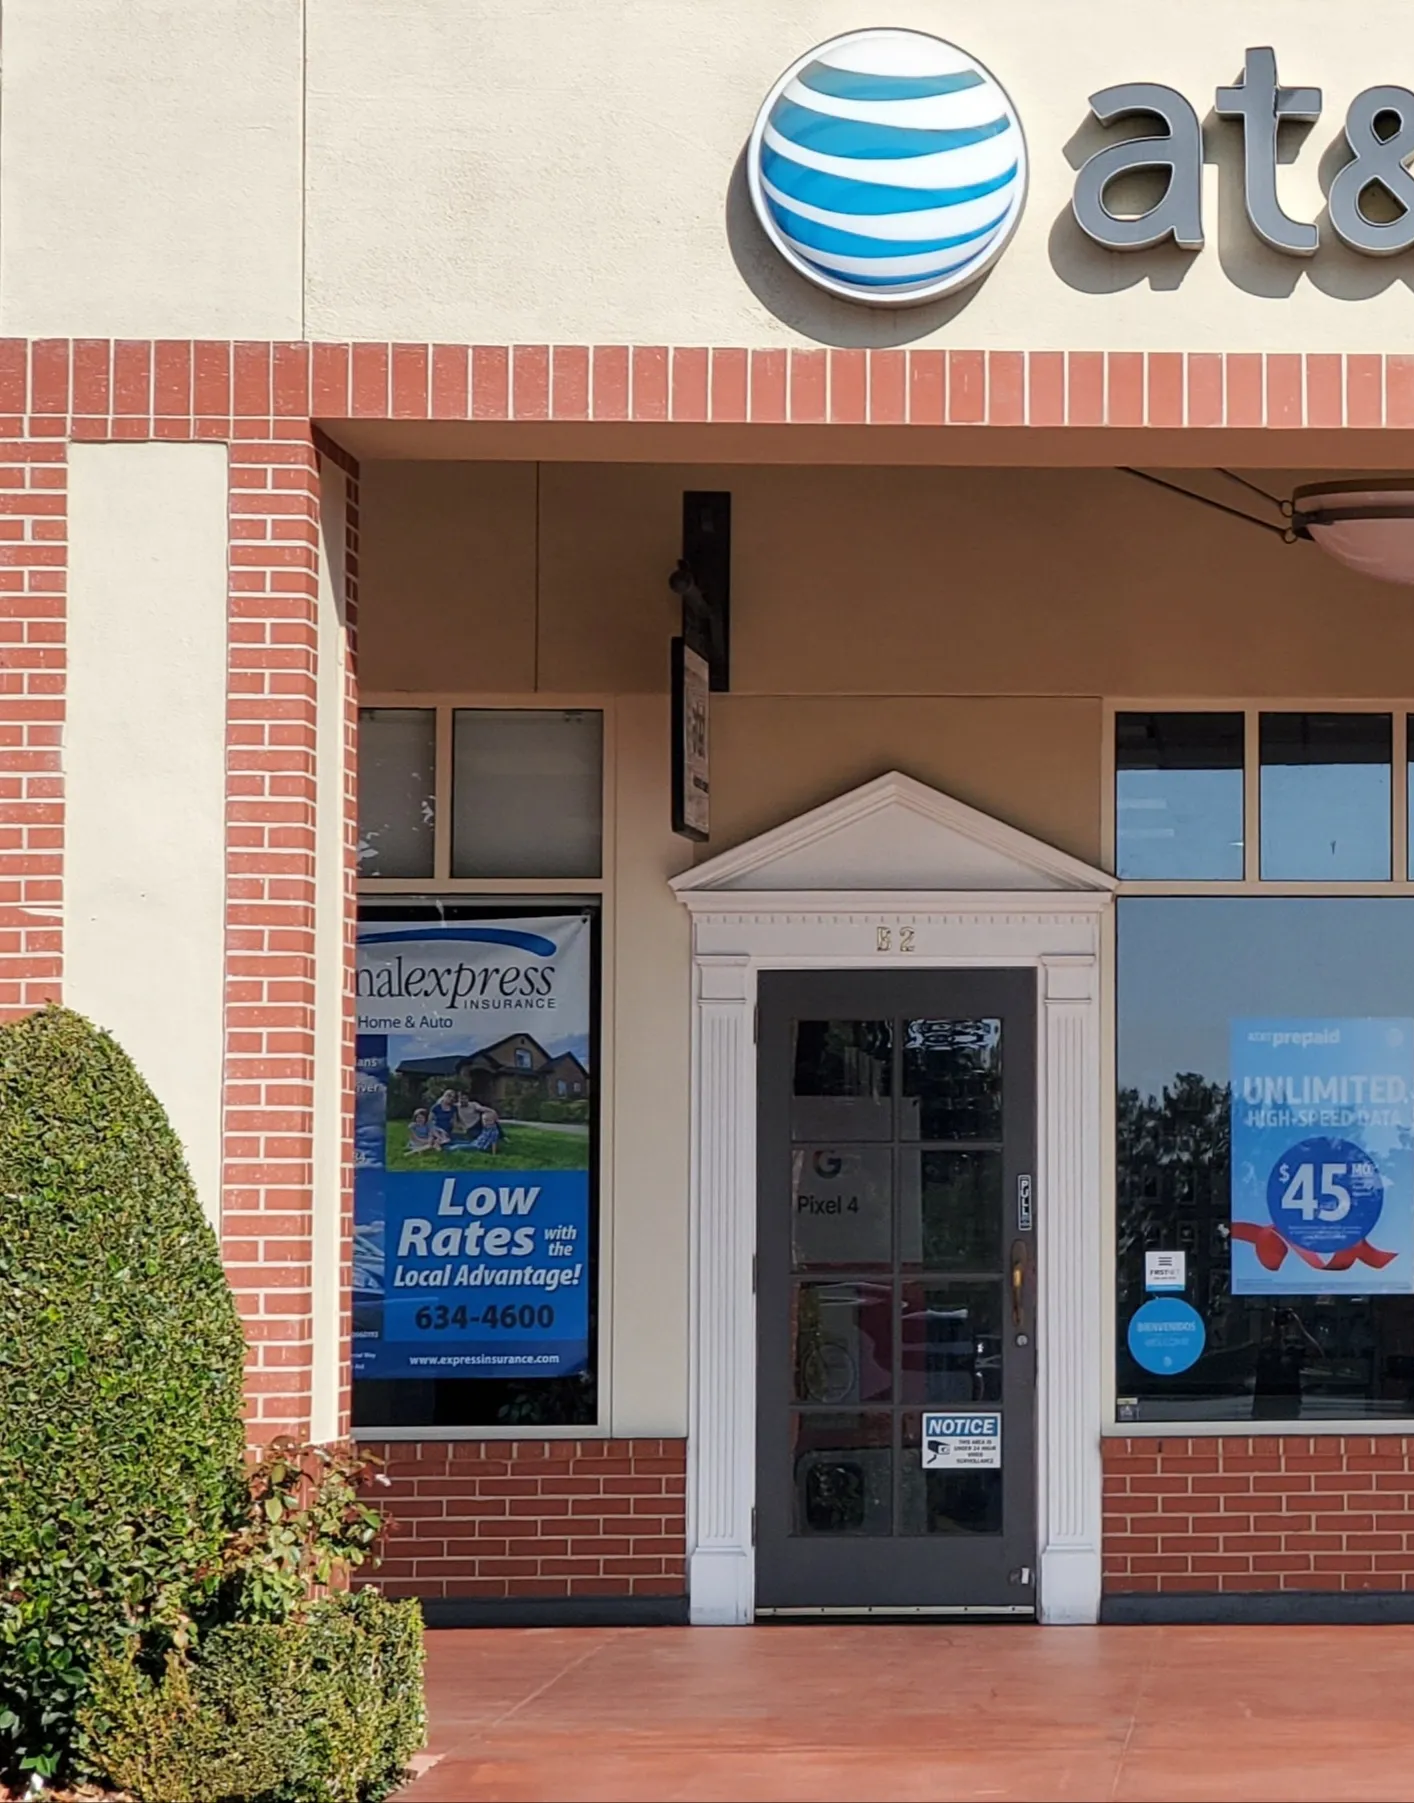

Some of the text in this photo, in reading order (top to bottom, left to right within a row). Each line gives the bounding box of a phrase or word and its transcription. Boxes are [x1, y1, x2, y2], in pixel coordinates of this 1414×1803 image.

[463, 998, 557, 1009] INSURANCE
[357, 1016, 454, 1028] Home & Auto
[1272, 1028, 1341, 1048] prepaid
[437, 1178, 541, 1216] Low
[797, 1194, 860, 1215] Pixel 4
[1020, 1180, 1029, 1216] PULL
[397, 1218, 536, 1257] Rates
[544, 1225, 577, 1240] with
[548, 1241, 573, 1256] the
[393, 1263, 583, 1291] Local Advantage!
[415, 1304, 555, 1330] 634-4600
[409, 1353, 560, 1367] www.expressinsurance.com
[928, 1419, 995, 1434] NOTICE
